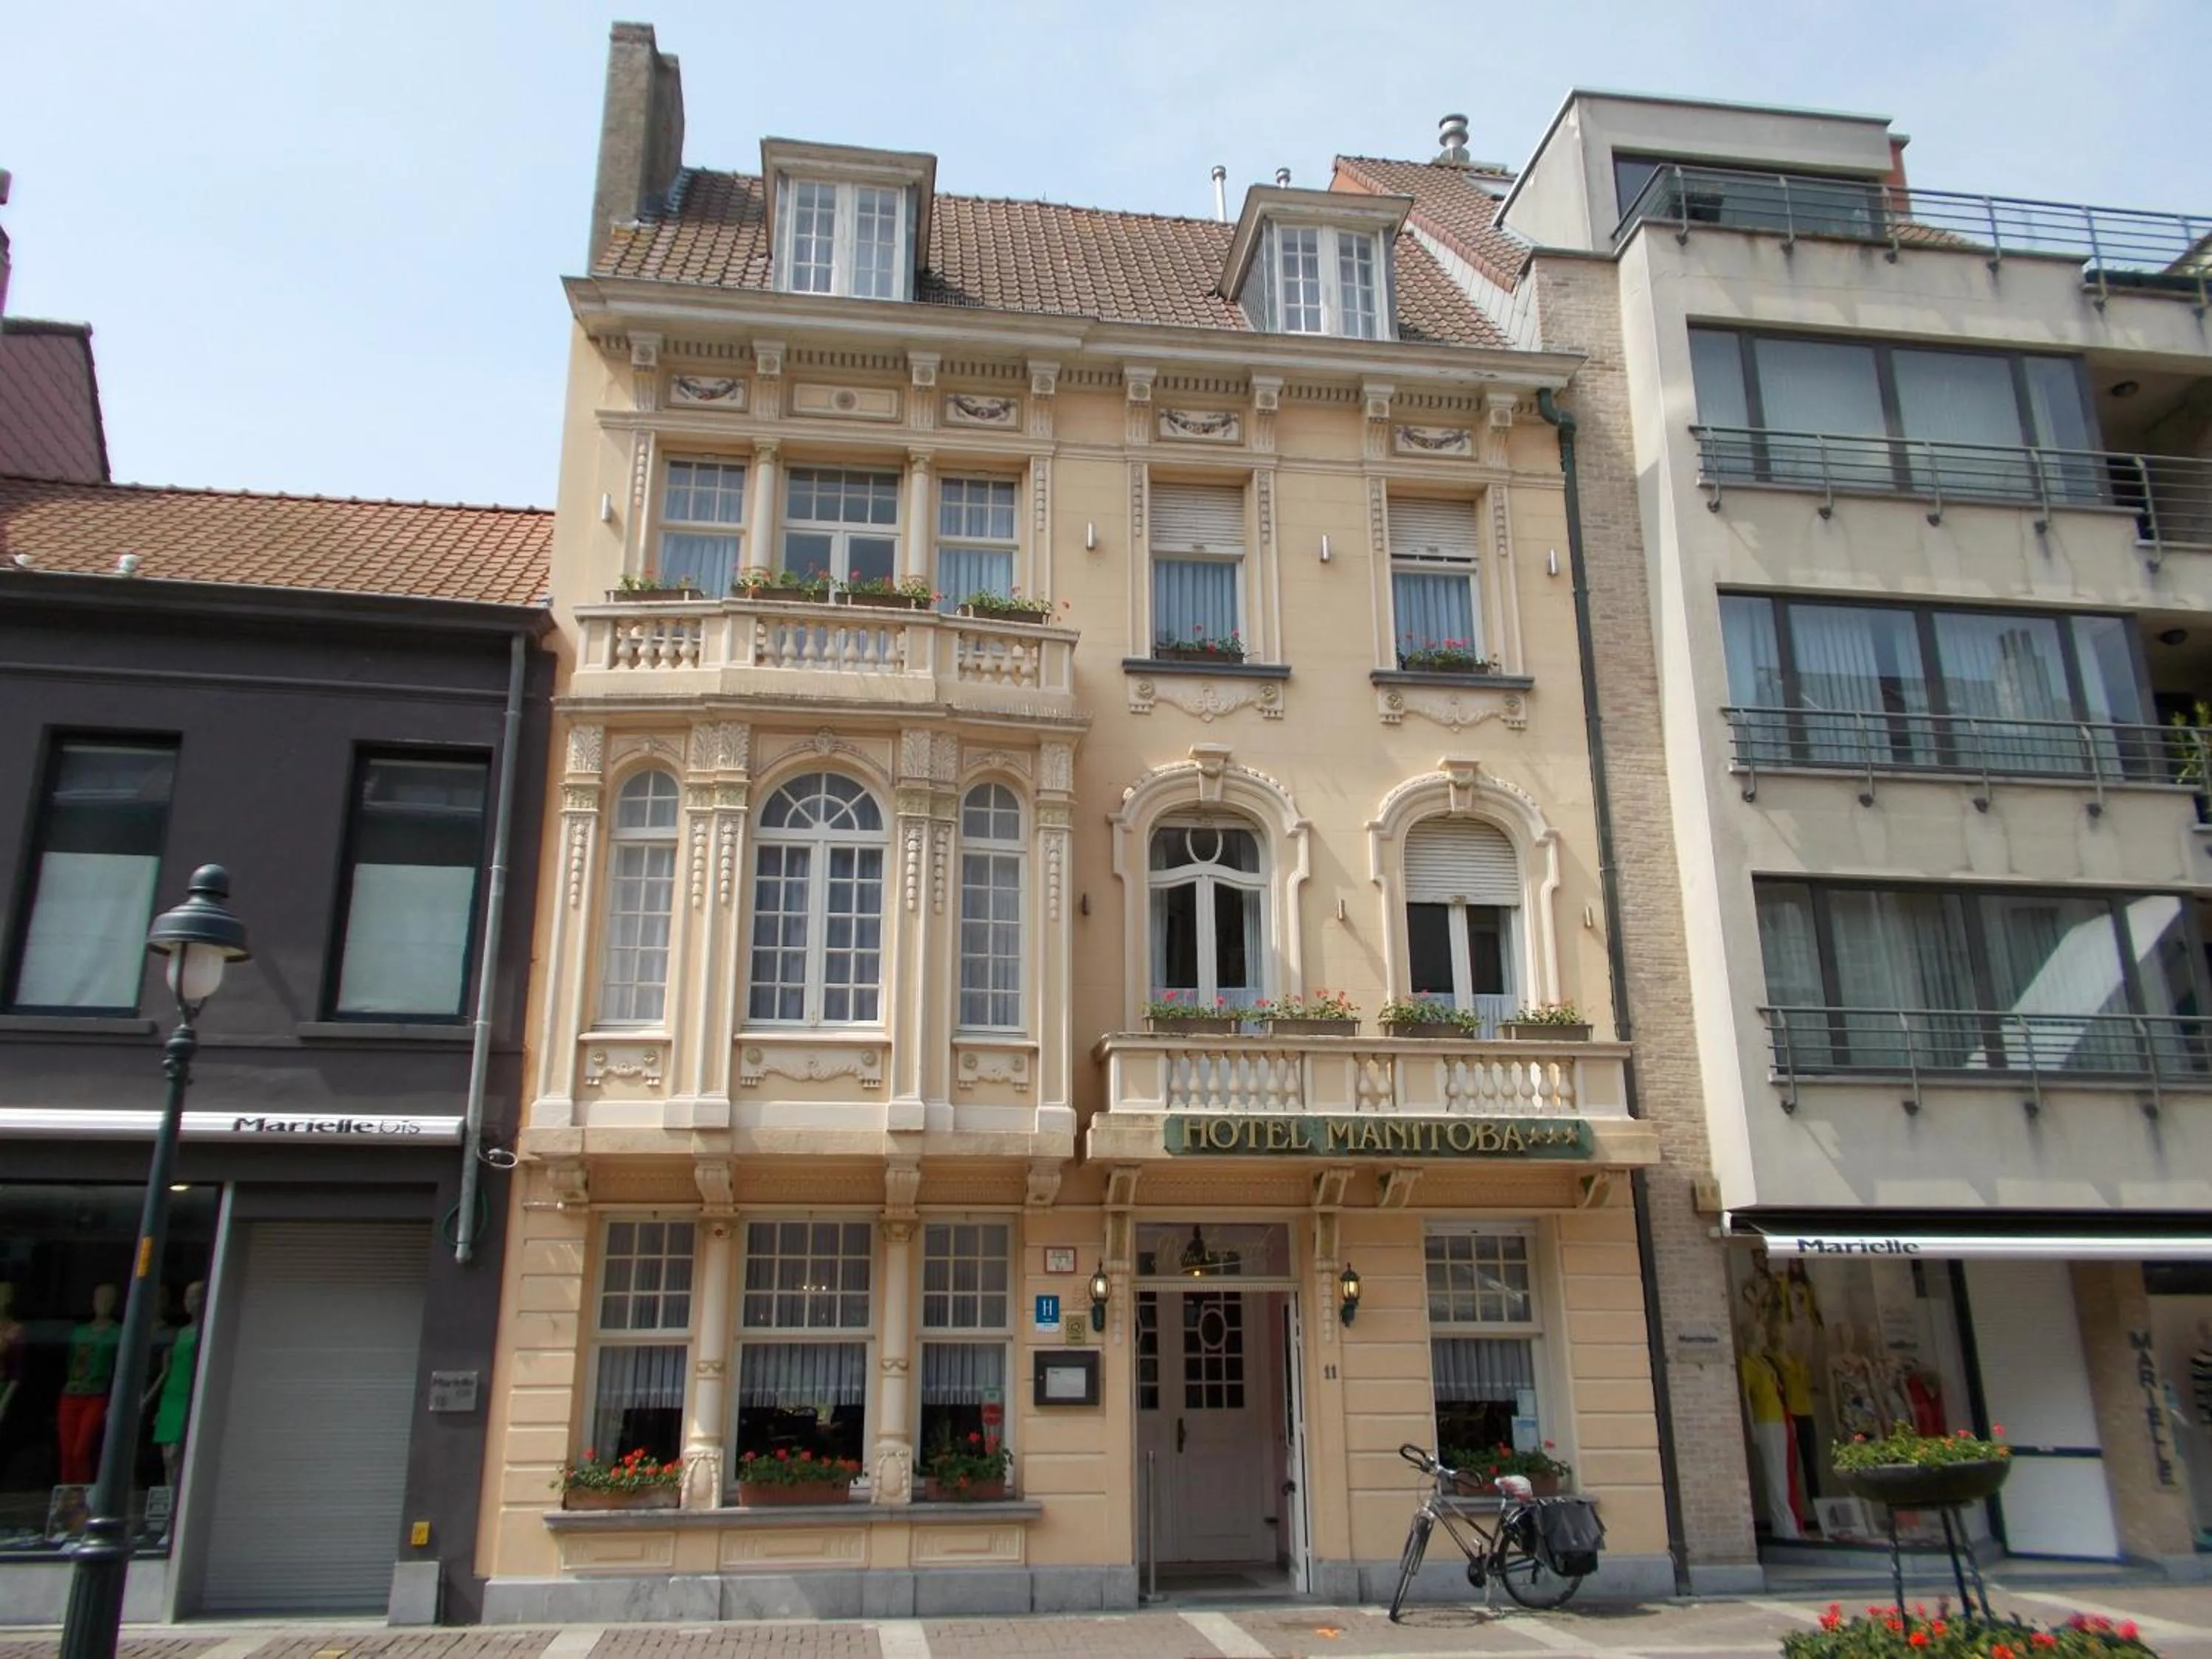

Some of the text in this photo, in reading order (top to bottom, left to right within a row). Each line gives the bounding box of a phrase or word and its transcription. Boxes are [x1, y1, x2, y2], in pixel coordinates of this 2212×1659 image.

[232, 1118, 374, 1133] Marielle
[1183, 1117, 1528, 1152] HOTEL MANITOBA
[1797, 1238, 1920, 1254] Marielle
[1324, 1363, 1337, 1380] 11
